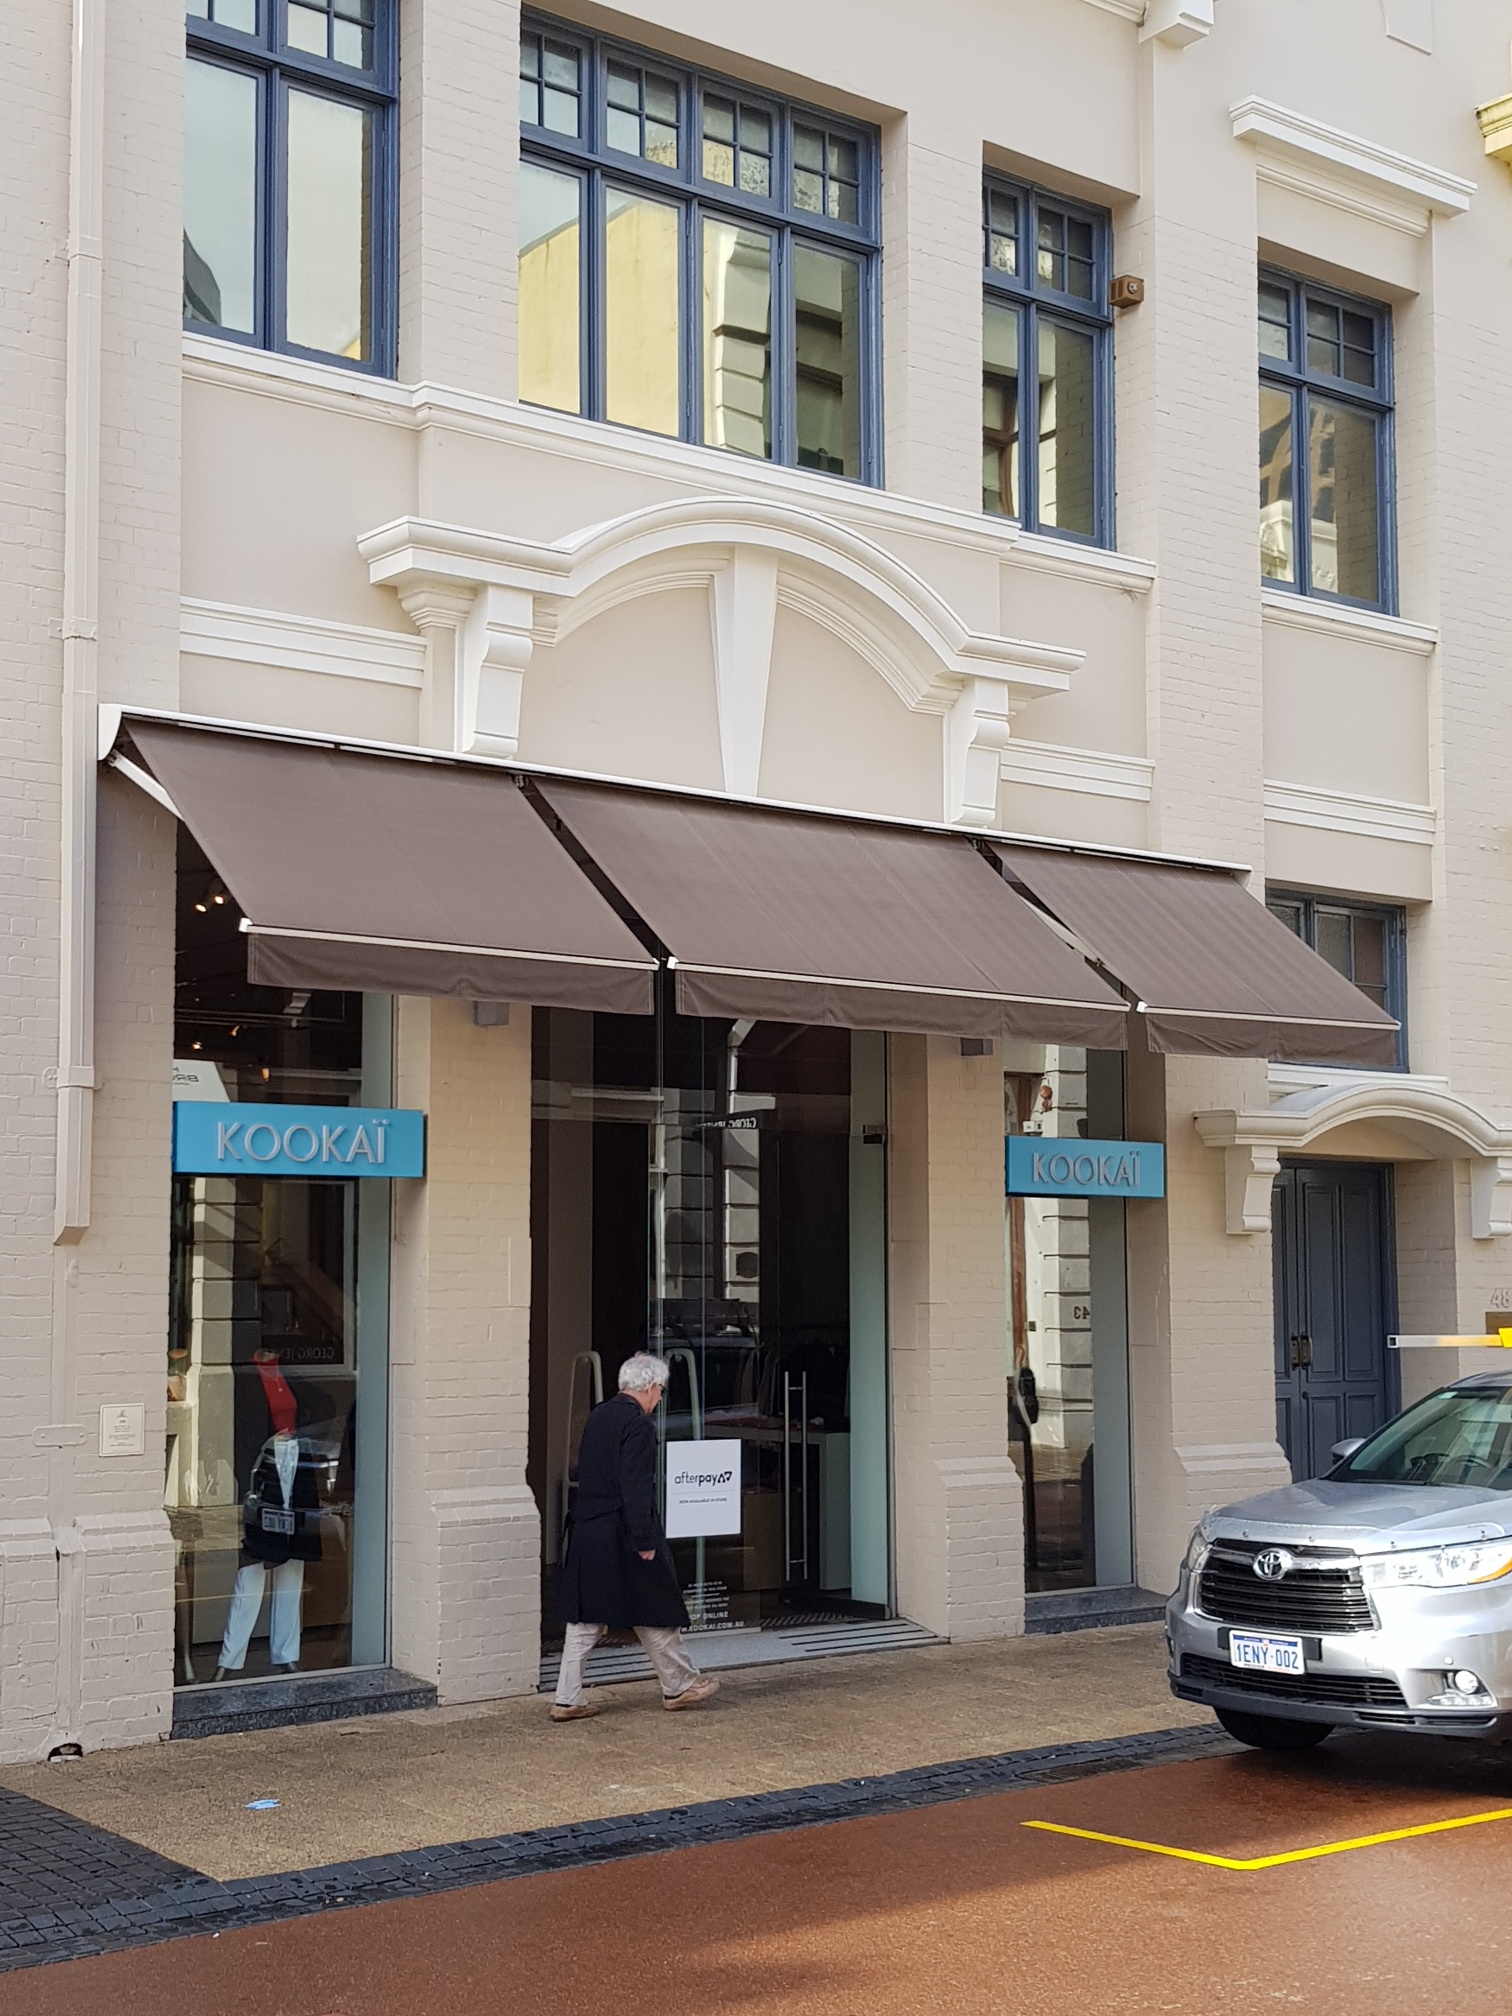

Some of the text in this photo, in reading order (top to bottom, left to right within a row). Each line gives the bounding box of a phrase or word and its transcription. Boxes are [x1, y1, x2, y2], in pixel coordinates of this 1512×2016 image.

[217, 1118, 390, 1165] KOOKAÏ
[1032, 1150, 1141, 1187] KOOKAÏ
[674, 1471, 717, 1487] afterpay
[703, 1611, 729, 1619] ONLINE
